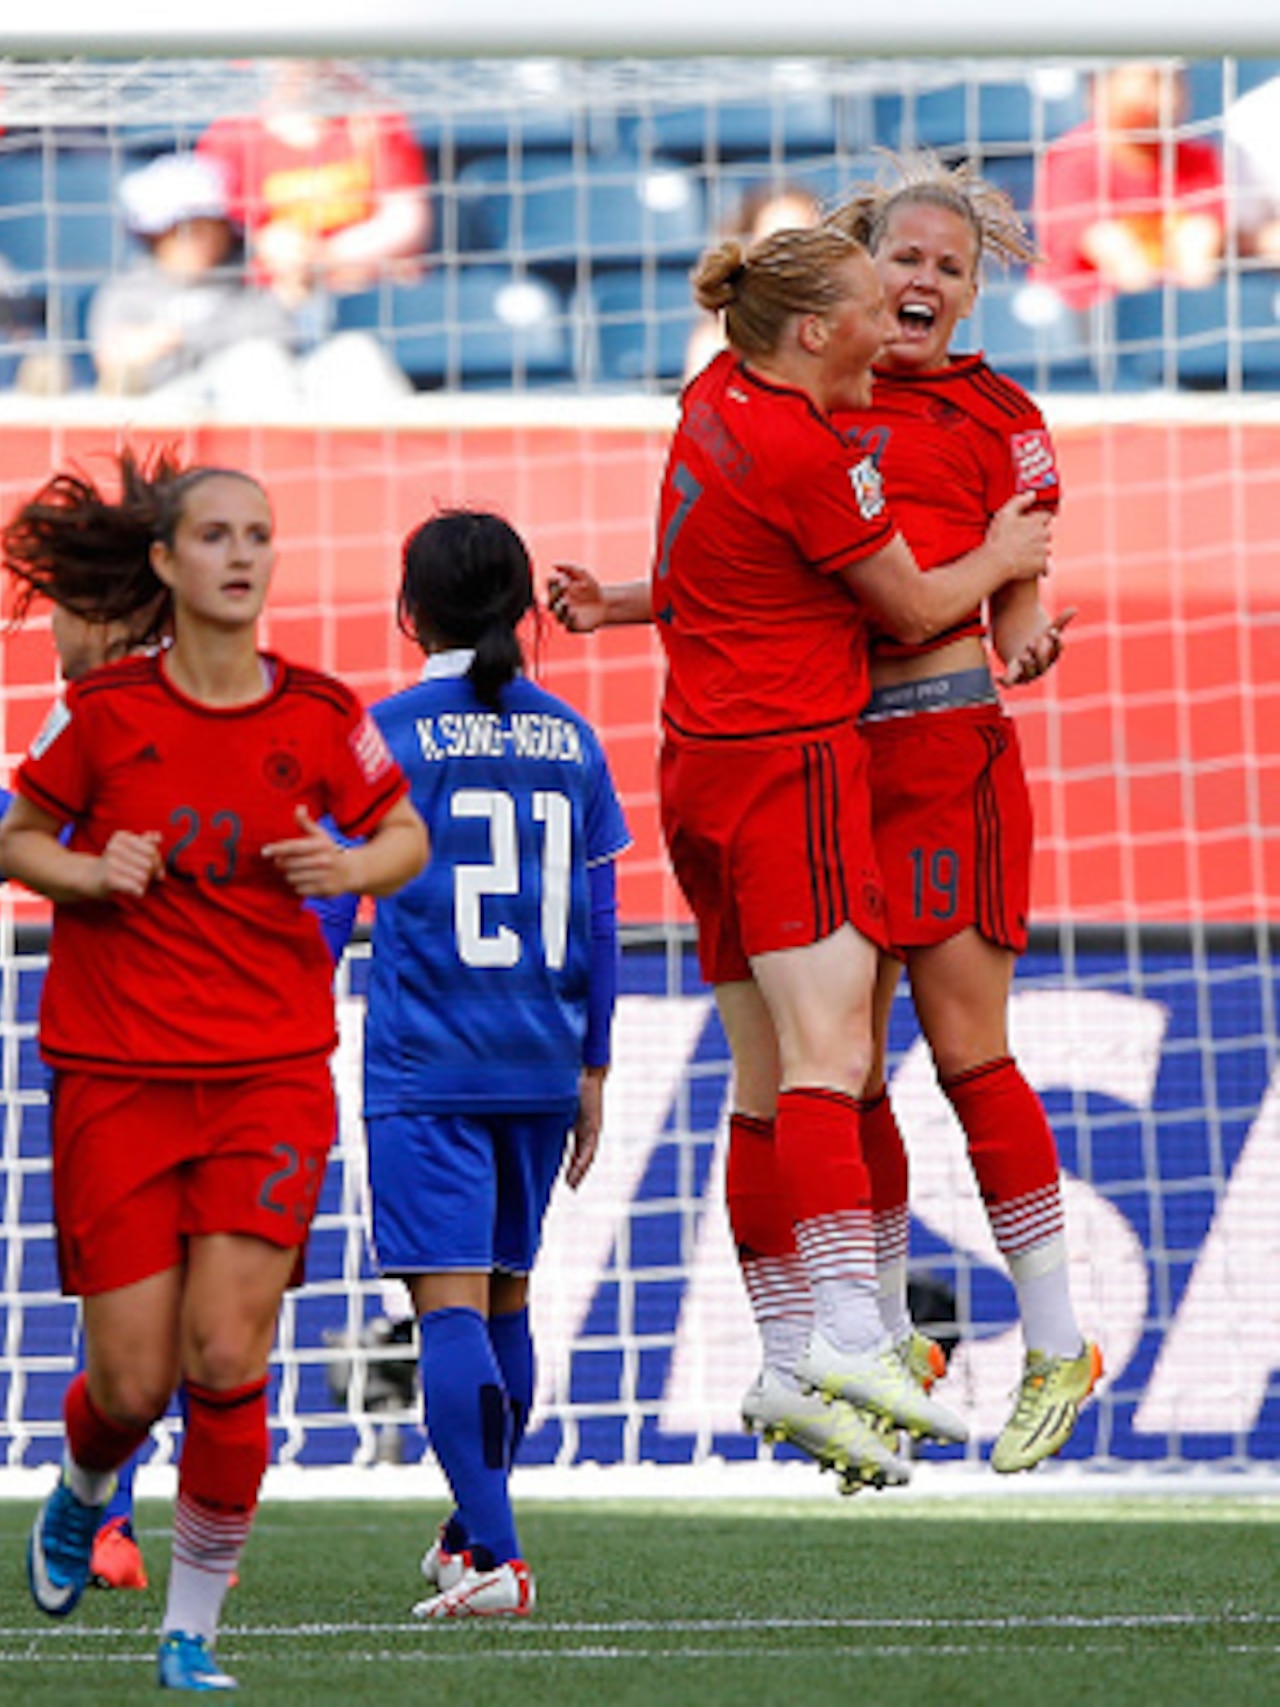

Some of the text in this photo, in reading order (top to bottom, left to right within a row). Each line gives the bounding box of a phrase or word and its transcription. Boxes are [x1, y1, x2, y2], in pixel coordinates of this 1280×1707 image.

[658, 460, 704, 580] 7
[166, 806, 243, 886] 23
[451, 787, 571, 969] 21
[908, 847, 960, 920] 19
